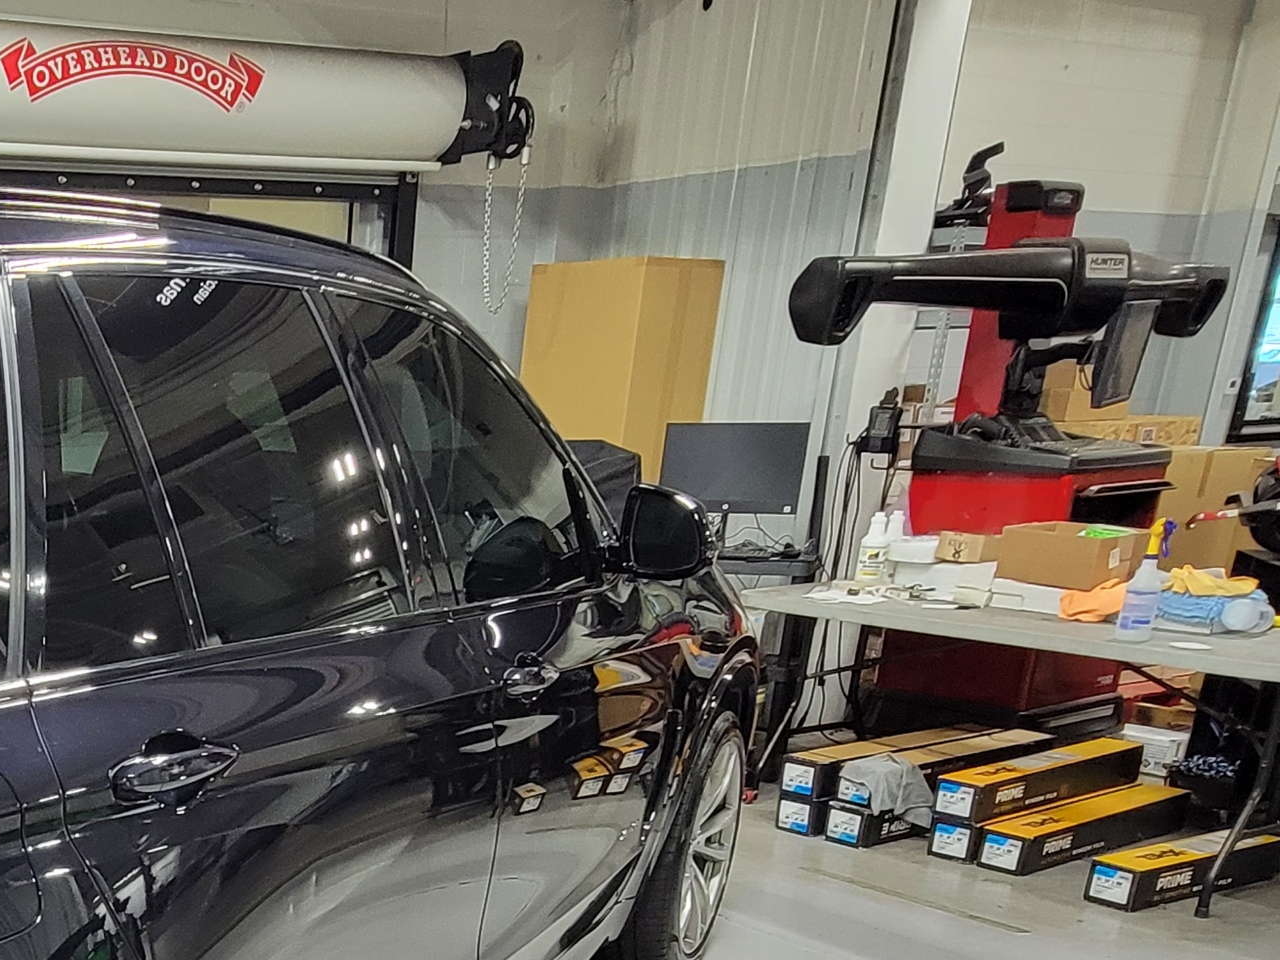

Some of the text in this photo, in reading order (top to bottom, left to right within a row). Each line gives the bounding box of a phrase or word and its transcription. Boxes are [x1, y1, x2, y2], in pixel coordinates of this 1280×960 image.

[31, 46, 236, 101] OVERHEAD DOOR
[1155, 871, 1194, 892] PRIME
